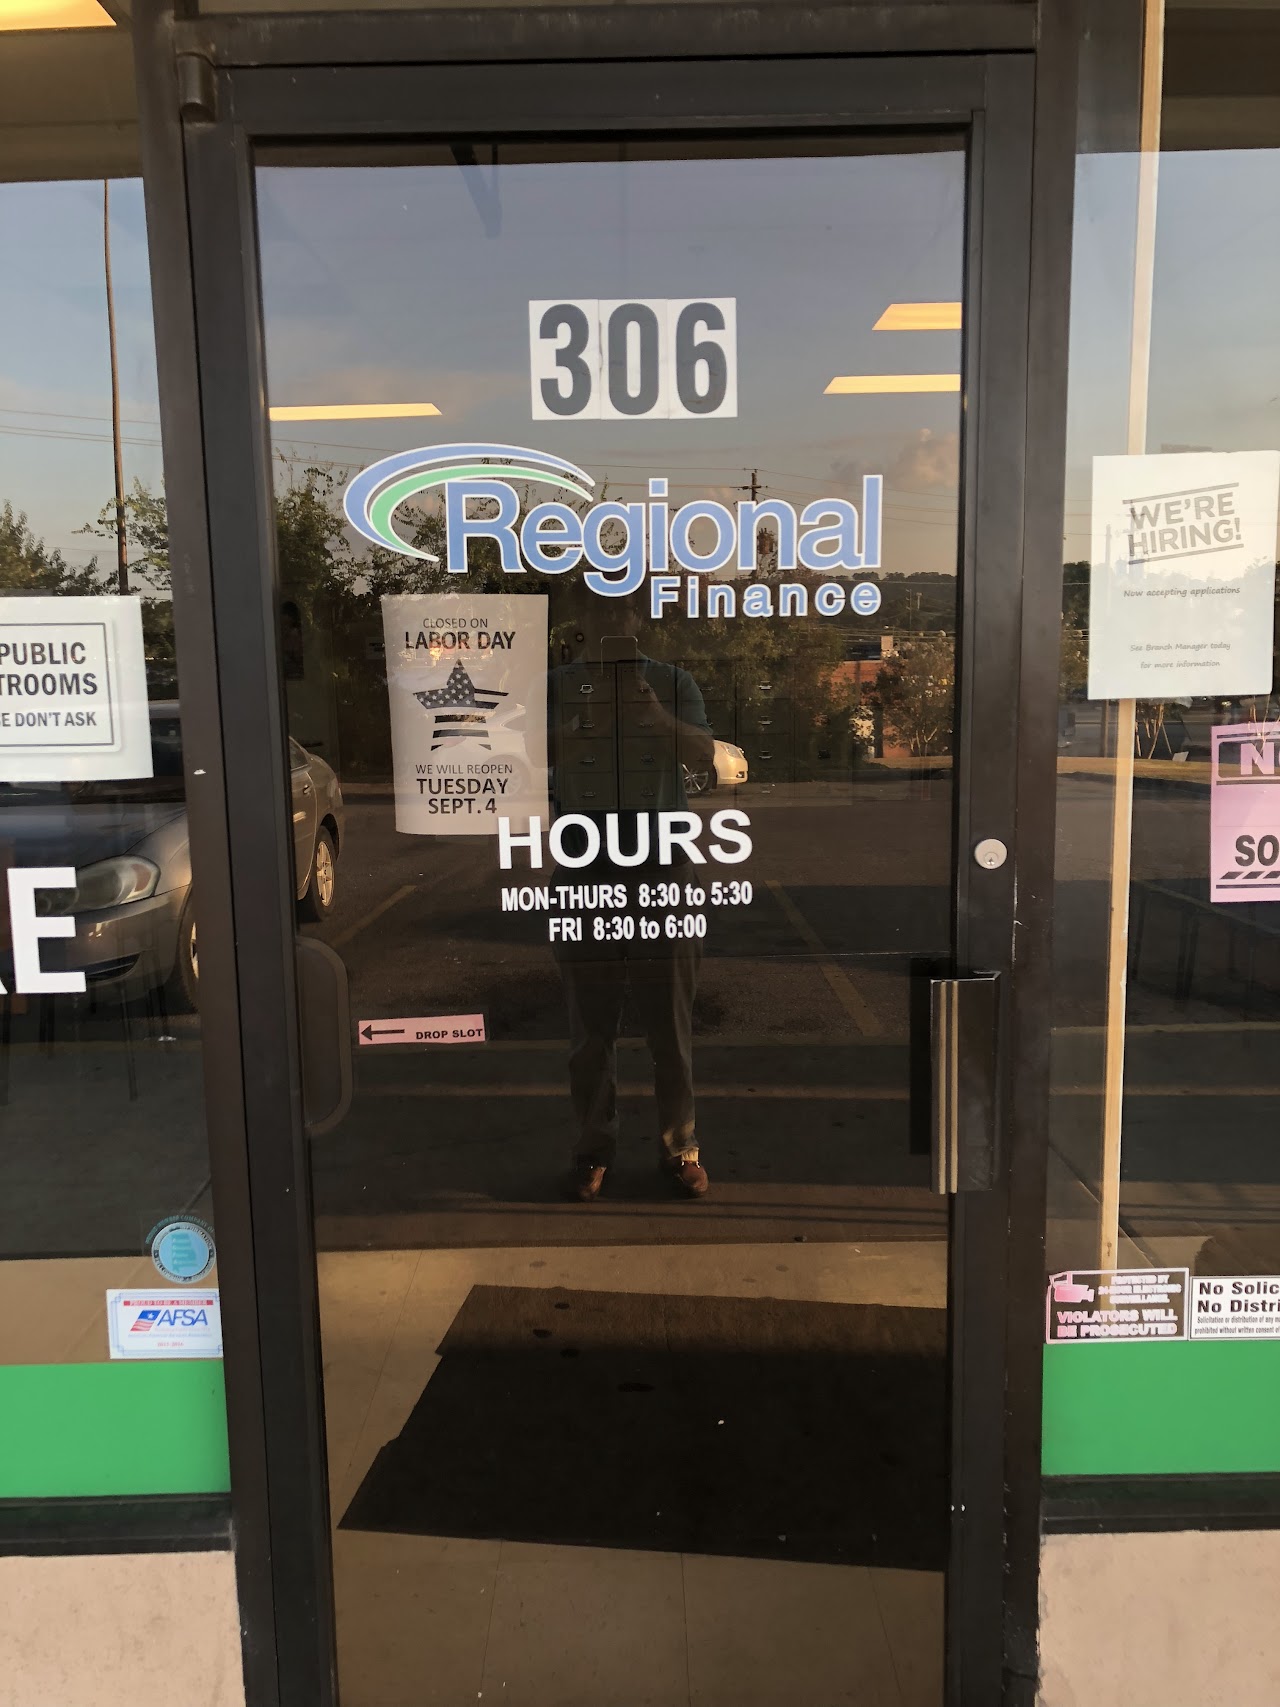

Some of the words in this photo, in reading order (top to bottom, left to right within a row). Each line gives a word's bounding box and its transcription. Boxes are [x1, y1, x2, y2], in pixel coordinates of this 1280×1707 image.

[539, 302, 727, 415] 306
[1129, 491, 1235, 530] WE'RE
[445, 474, 883, 597] Regional
[1128, 517, 1242, 557] HIRING!
[650, 575, 882, 619] Finance
[1123, 590, 1143, 598] Now
[1146, 588, 1188, 598] accepting
[1190, 586, 1241, 597] applications
[423, 618, 467, 629] CLOSED
[470, 618, 488, 629] ON
[405, 631, 471, 650] LABOR
[477, 631, 516, 650] DAY
[1130, 644, 1143, 652] See
[1146, 643, 1173, 652] Branch
[1175, 643, 1208, 652] Manager
[1210, 642, 1231, 650] today
[0, 641, 86, 666] PUBLIC
[1140, 661, 1152, 669] for
[1176, 660, 1221, 668] information
[15, 712, 61, 727] DON'T
[64, 711, 97, 727] ASK
[1240, 742, 1280, 775] N
[415, 764, 433, 775] WE
[436, 764, 464, 774] WILL
[467, 764, 513, 774] REOPEN
[416, 777, 509, 795] TUESDAY
[428, 797, 482, 814] SEPT.
[485, 797, 497, 814] 4
[497, 808, 753, 870] HOURS
[1235, 834, 1280, 867] SO
[501, 884, 628, 912] MON-THURS
[638, 882, 681, 907] 8:30
[685, 882, 706, 906] to
[710, 880, 753, 906] 5:30
[0, 866, 87, 994] E
[549, 916, 583, 942] FRI
[593, 915, 635, 940] 8:30
[640, 915, 661, 939] to
[665, 914, 708, 939] 6:00
[415, 1030, 449, 1040] DROP
[452, 1028, 483, 1038] SLOT
[1199, 1281, 1224, 1295] No
[1231, 1281, 1280, 1295] Solic
[1197, 1300, 1222, 1313] No
[157, 1309, 208, 1326] AFSA
[1057, 1309, 1140, 1323] VIOLATORS
[1142, 1308, 1178, 1321] WILL
[1197, 1316, 1224, 1324] Solicitation
[1231, 1315, 1258, 1323] distribution
[1057, 1324, 1077, 1338] BE
[1080, 1322, 1178, 1337] PROSECUTED
[1194, 1326, 1219, 1335] prohibited
[1220, 1326, 1237, 1334] without
